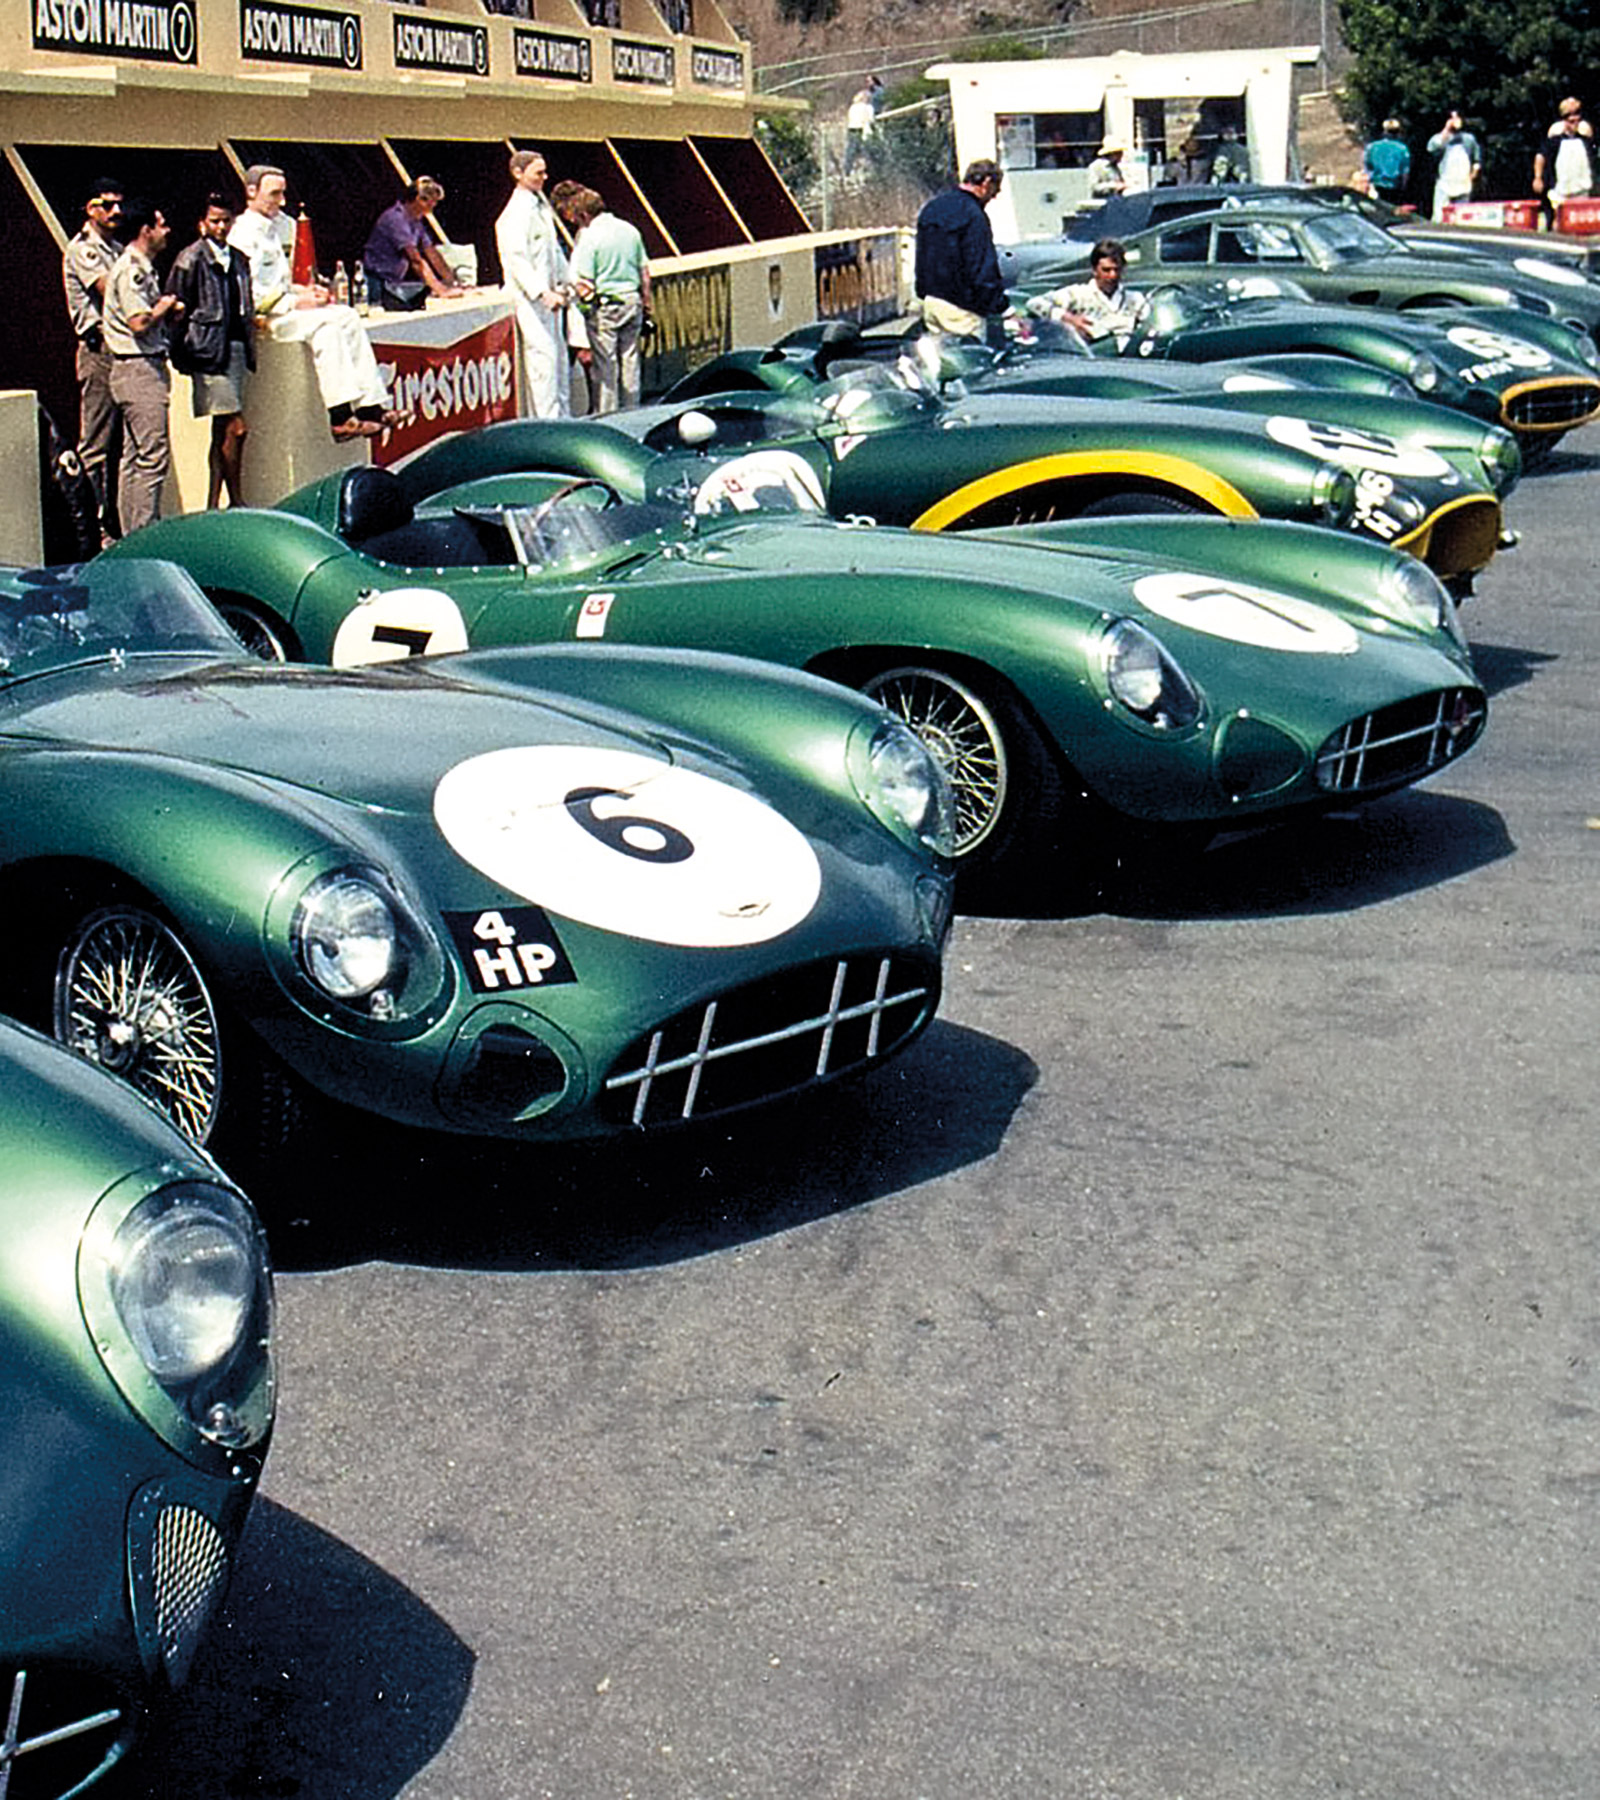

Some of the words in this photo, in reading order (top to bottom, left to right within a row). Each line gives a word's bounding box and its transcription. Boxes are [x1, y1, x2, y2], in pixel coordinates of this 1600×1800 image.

[36, 0, 101, 43] ASTON
[106, 2, 169, 50] MARTIN
[244, 8, 291, 53] ASTON
[294, 16, 342, 58] MARTIN
[397, 24, 434, 61] ASTON
[1176, 588, 1316, 633] 7
[563, 786, 695, 863] 6
[473, 911, 516, 945] 4
[473, 943, 557, 987] HP
